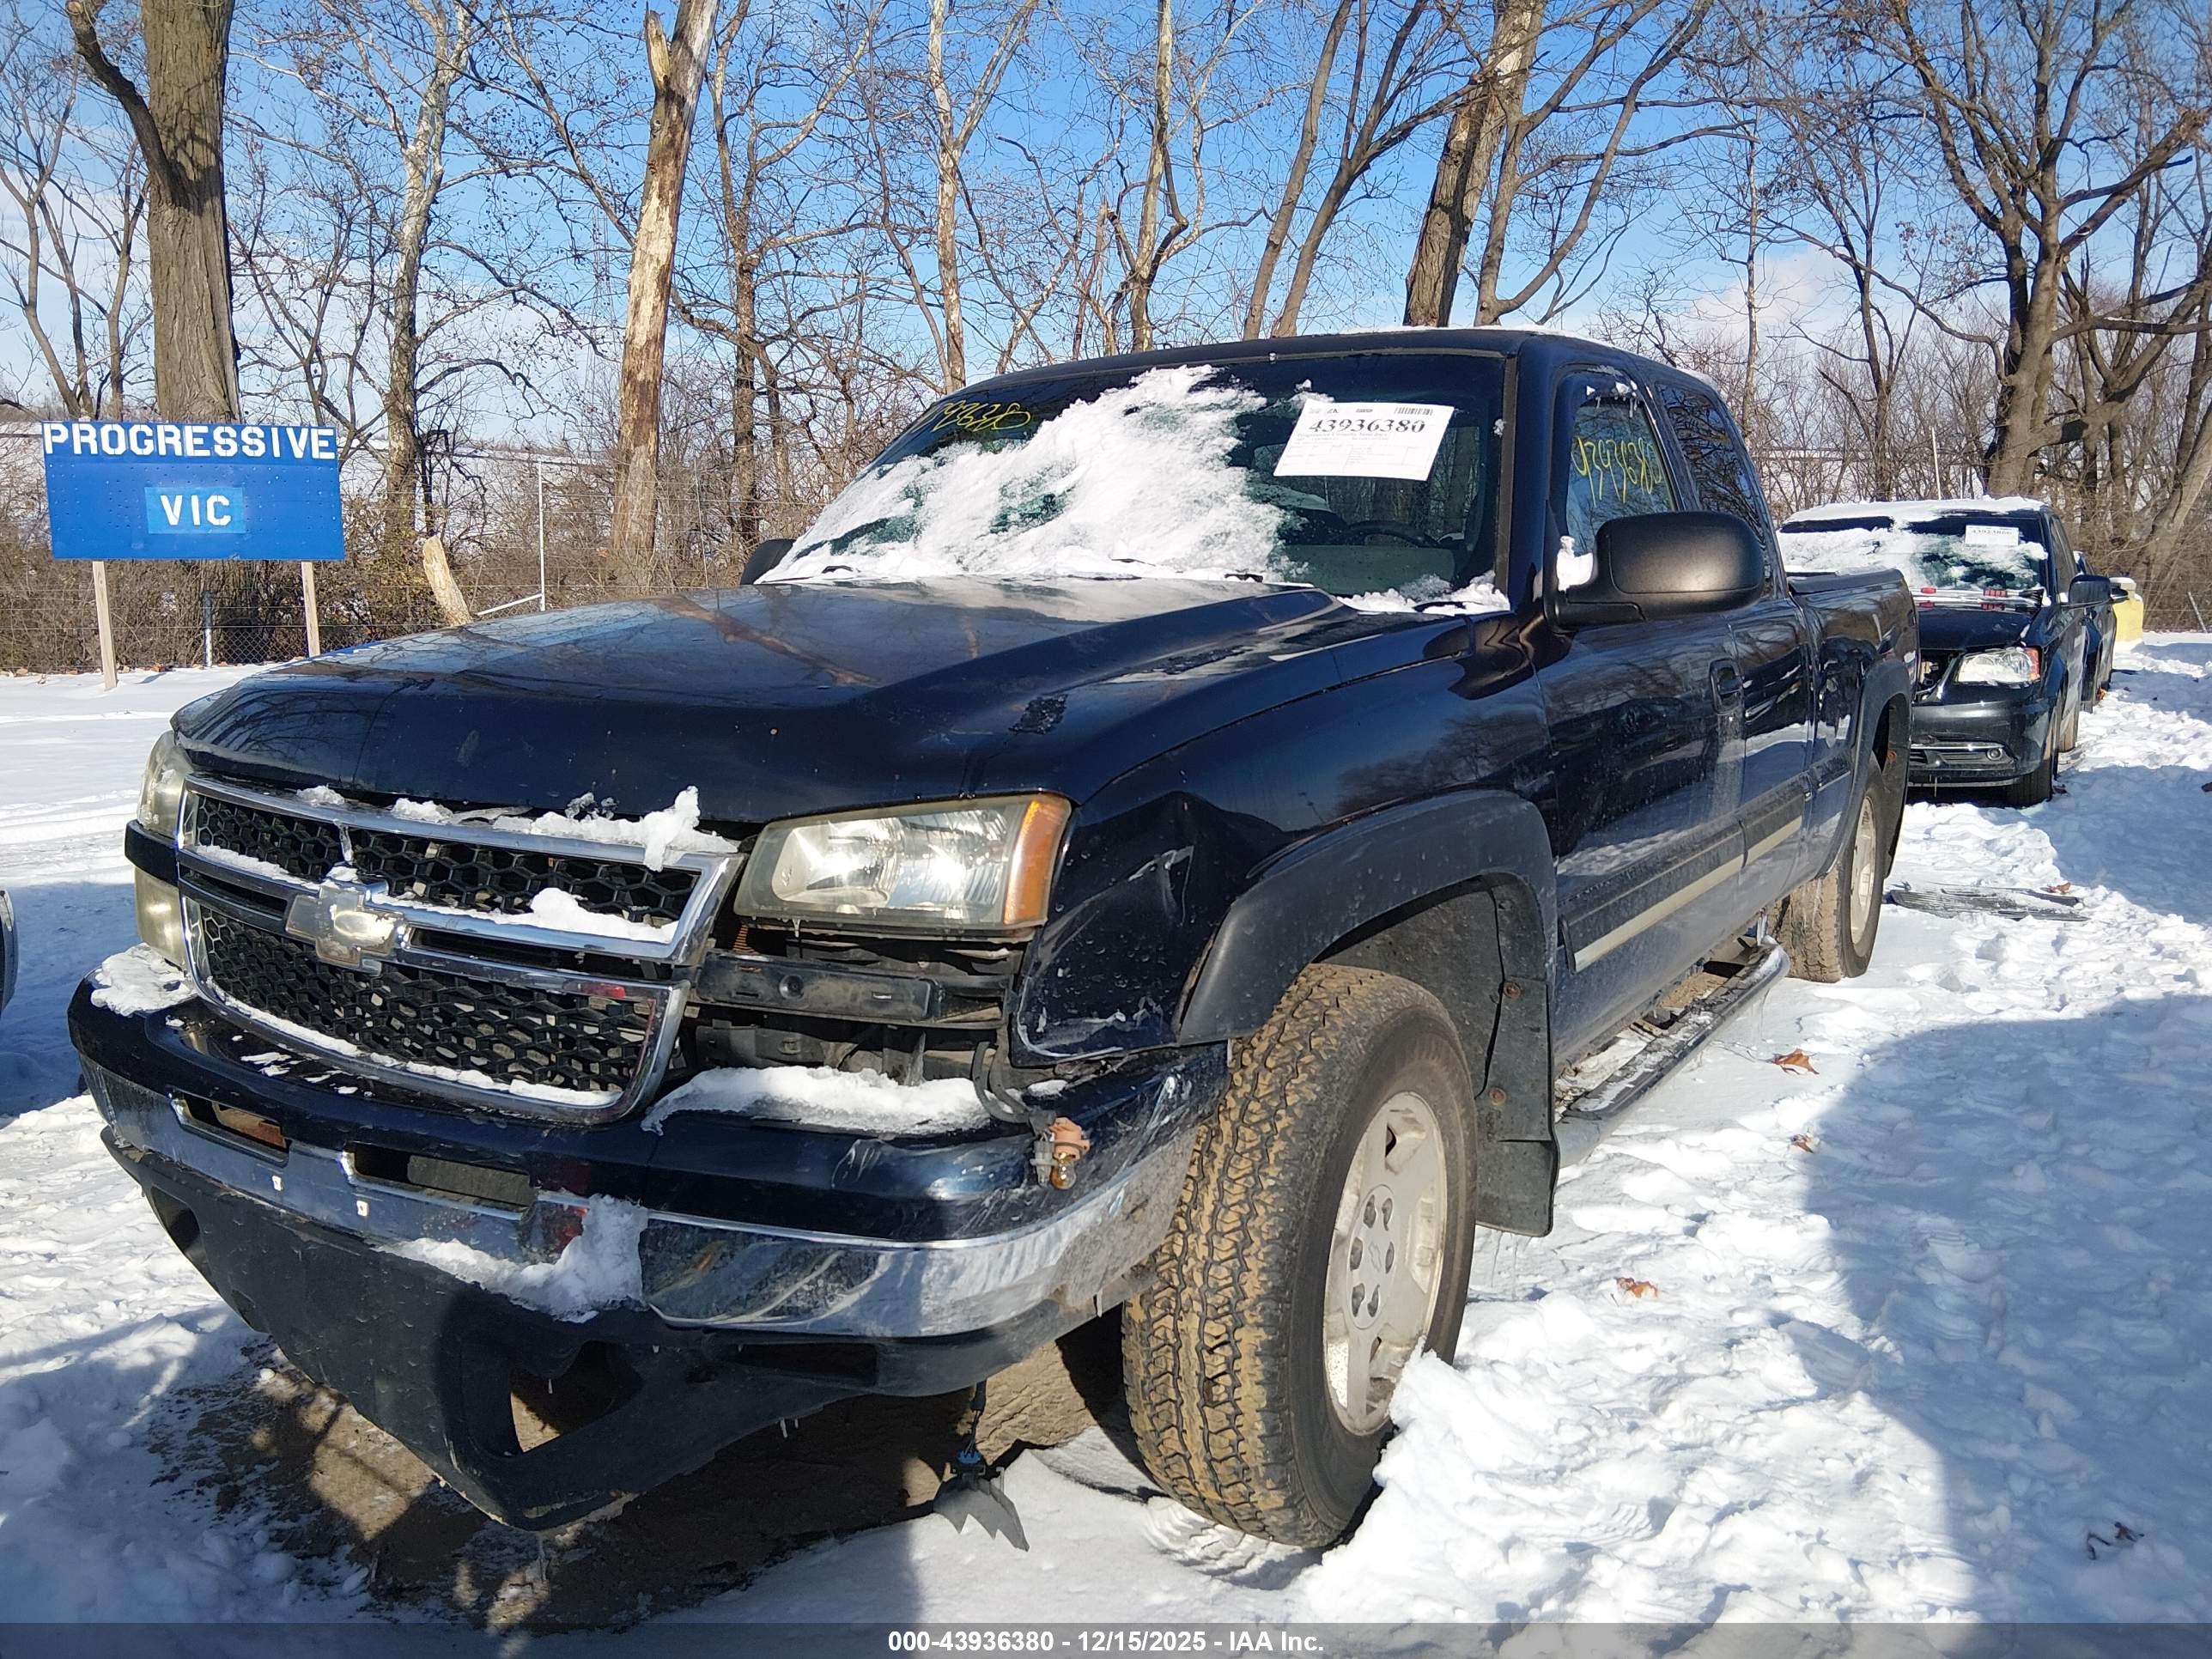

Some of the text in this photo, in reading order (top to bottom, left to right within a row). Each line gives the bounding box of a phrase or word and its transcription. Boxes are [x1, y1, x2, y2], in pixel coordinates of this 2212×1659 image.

[43, 422, 336, 460] PROGRESSIVE
[1309, 418, 1426, 433] 43936380
[160, 494, 232, 526] VIC
